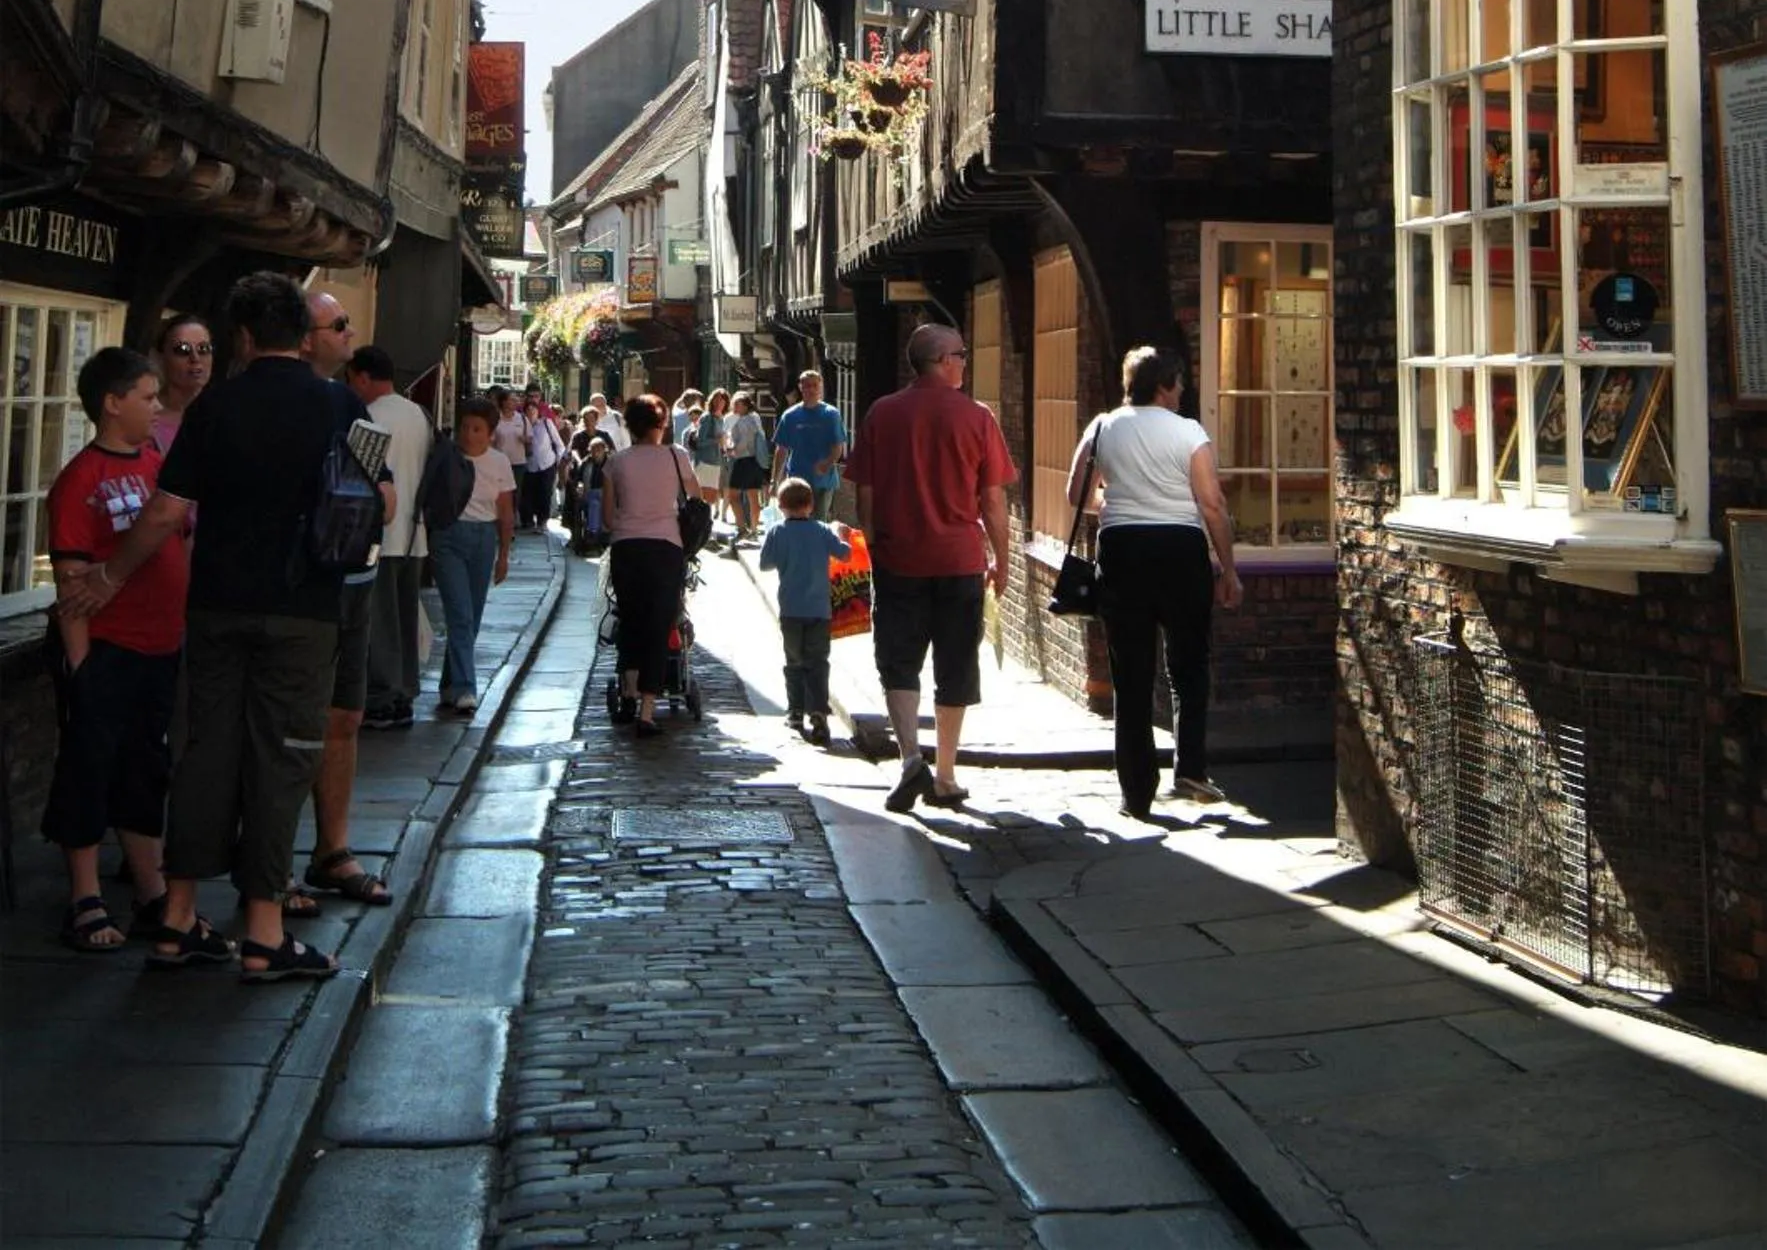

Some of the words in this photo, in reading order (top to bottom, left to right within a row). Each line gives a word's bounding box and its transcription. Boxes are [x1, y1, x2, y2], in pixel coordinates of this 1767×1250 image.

[1275, 12, 1333, 40] SHA
[45, 210, 120, 265] HEAVEN
[1606, 316, 1641, 333] OPEN
